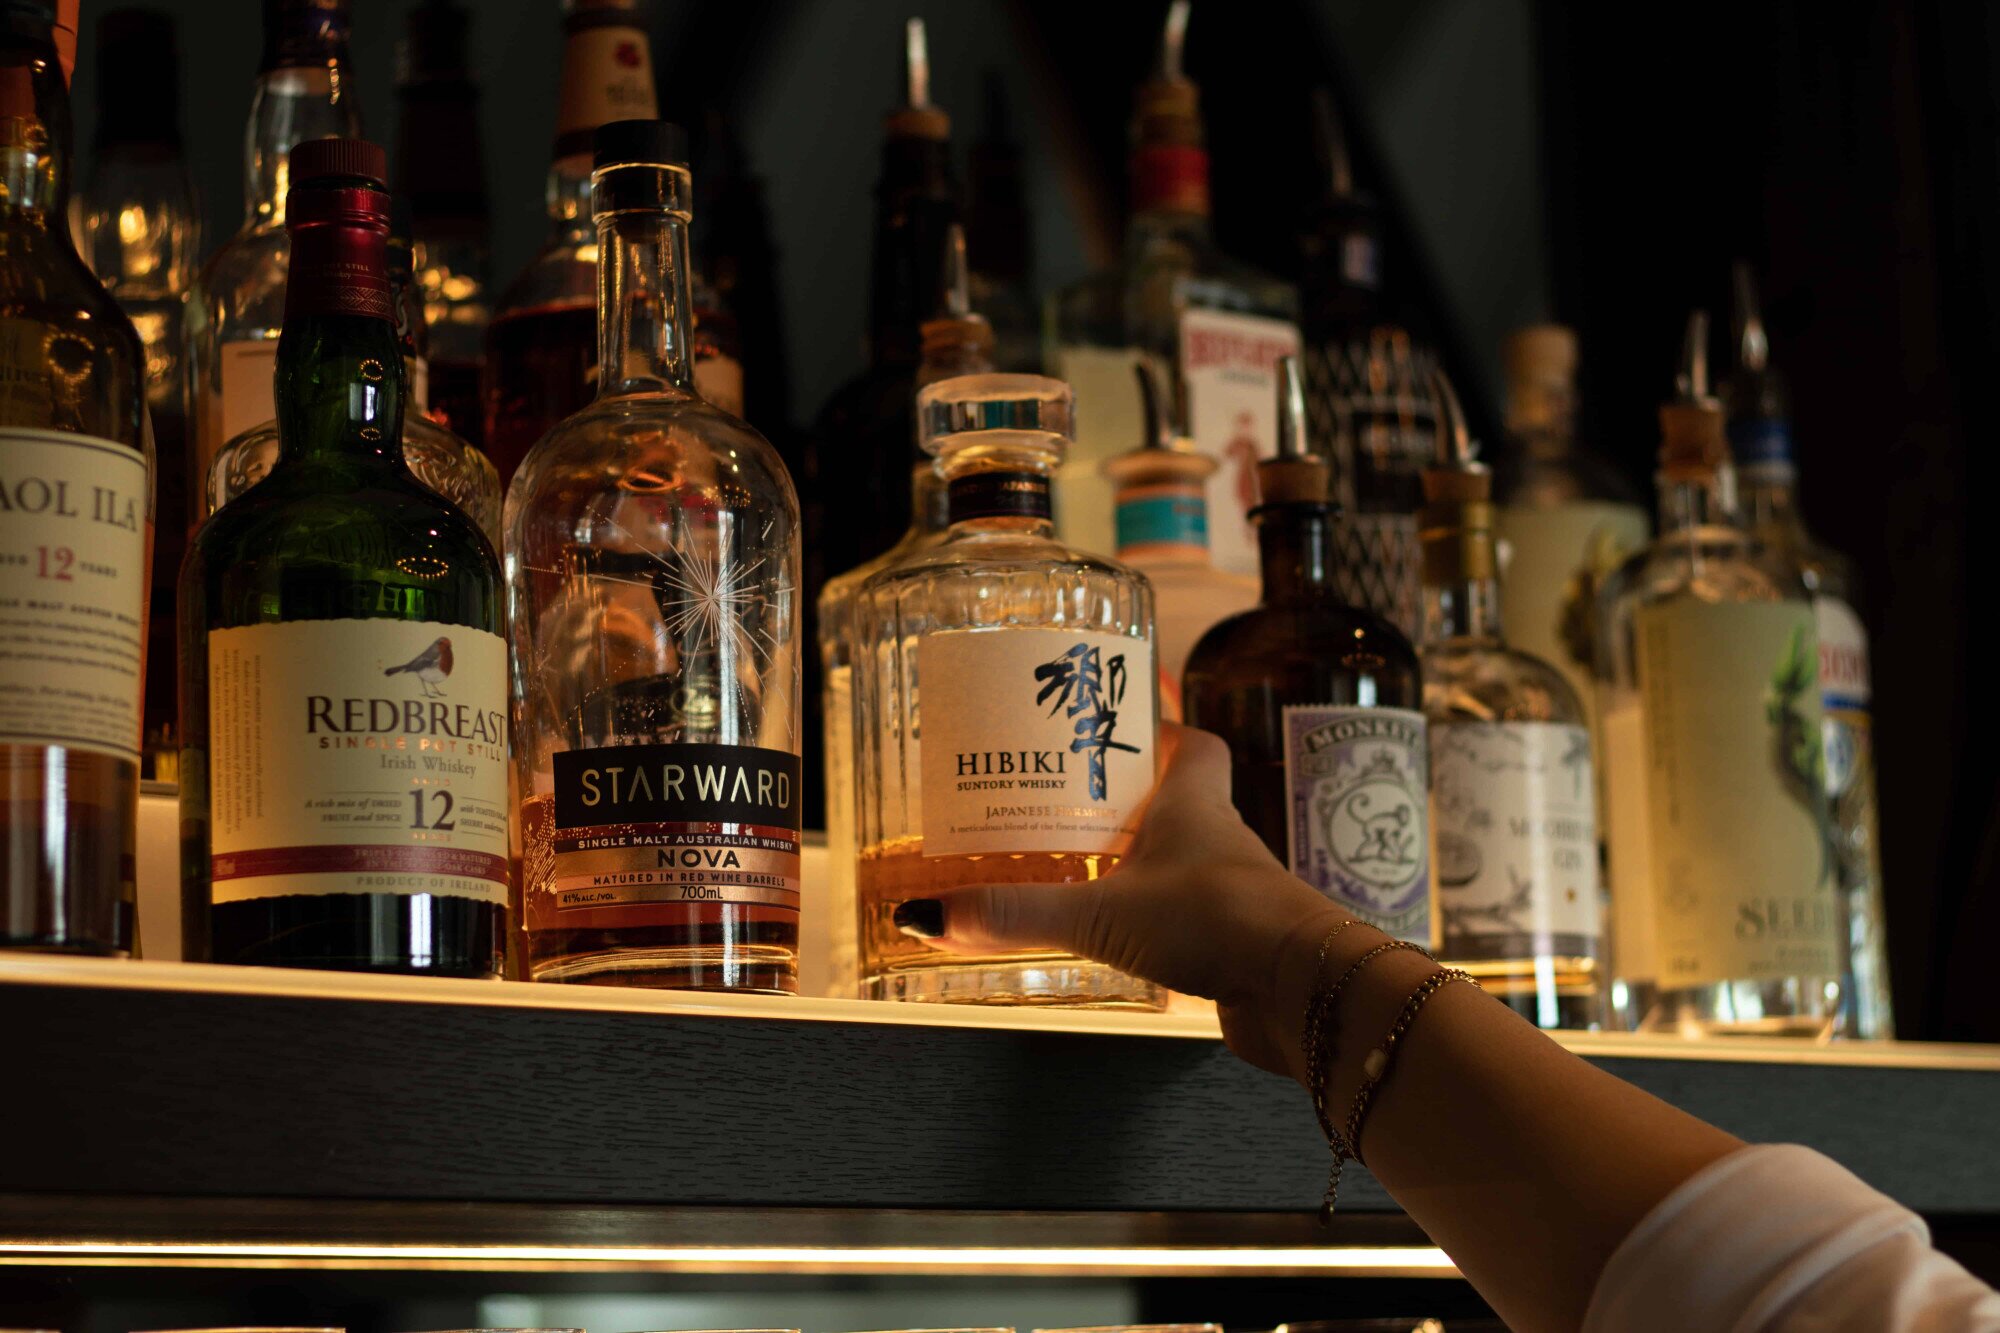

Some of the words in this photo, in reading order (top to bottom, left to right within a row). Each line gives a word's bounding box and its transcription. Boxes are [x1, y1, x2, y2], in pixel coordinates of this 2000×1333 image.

[93, 486, 138, 532] ILA
[37, 545, 75, 580] 12
[307, 696, 505, 747] REDBREAST
[1305, 718, 1420, 753] MONKEY
[319, 737, 408, 752] SINGLE
[420, 738, 457, 752] POT
[467, 743, 501, 762] STILL
[380, 754, 417, 770] Irish
[423, 756, 476, 778] Whiskey
[956, 751, 1066, 776] HIBIKI
[581, 764, 790, 810] STARWARD
[956, 780, 1014, 791] SUNTORY
[1018, 779, 1067, 790] WHISKY
[315, 798, 335, 808] rich
[337, 799, 355, 808] mix
[358, 797, 369, 811] of
[408, 788, 456, 831] 12
[985, 805, 1052, 820] JAPANESE
[353, 813, 372, 822] and
[950, 825, 955, 833] A
[957, 824, 1003, 834] meticulous
[1004, 822, 1028, 832] blend
[1030, 822, 1039, 832] of
[1040, 822, 1054, 831] the
[1055, 822, 1077, 831] finest
[578, 837, 626, 849] SINGLE
[633, 835, 669, 845] MALT
[676, 835, 758, 847] AUSTRALIAN
[762, 838, 793, 851] WHISKY
[657, 849, 741, 868] NOVA
[445, 863, 463, 871] OAK
[464, 864, 487, 874] CASKS
[357, 876, 424, 887] PRODUCT
[430, 878, 445, 888] OF
[449, 879, 491, 893] IRELAND
[594, 873, 653, 885] MATURED
[660, 873, 673, 882] IN
[680, 872, 704, 882] RED
[710, 872, 741, 883] WINE
[746, 875, 785, 887] BARRELS
[680, 886, 723, 900] 700mL
